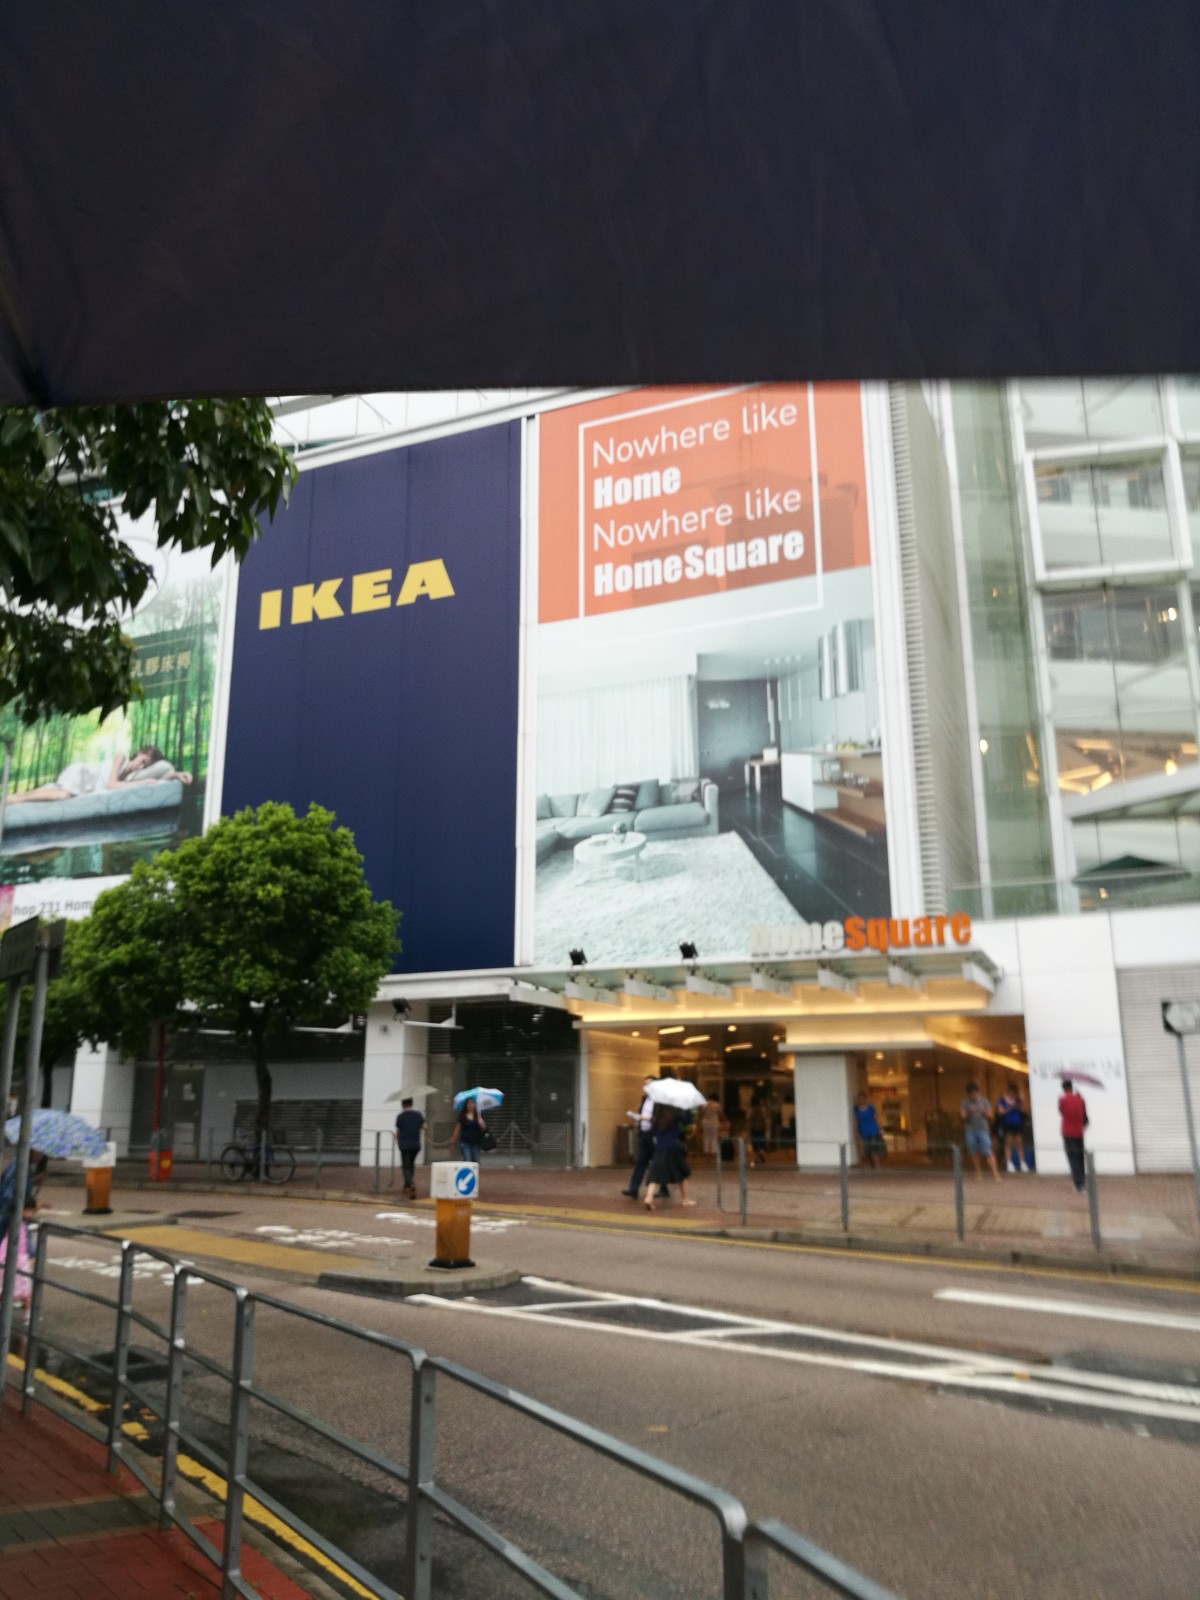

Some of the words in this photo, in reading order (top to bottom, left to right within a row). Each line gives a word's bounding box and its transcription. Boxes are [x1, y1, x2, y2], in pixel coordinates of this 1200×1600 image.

[593, 419, 729, 467] Nowhere
[742, 402, 797, 434] like
[593, 467, 681, 508] Home
[593, 502, 733, 551] Nowhere
[745, 488, 802, 521] like
[259, 558, 456, 630] IKEA
[594, 531, 804, 597] HomeSquare
